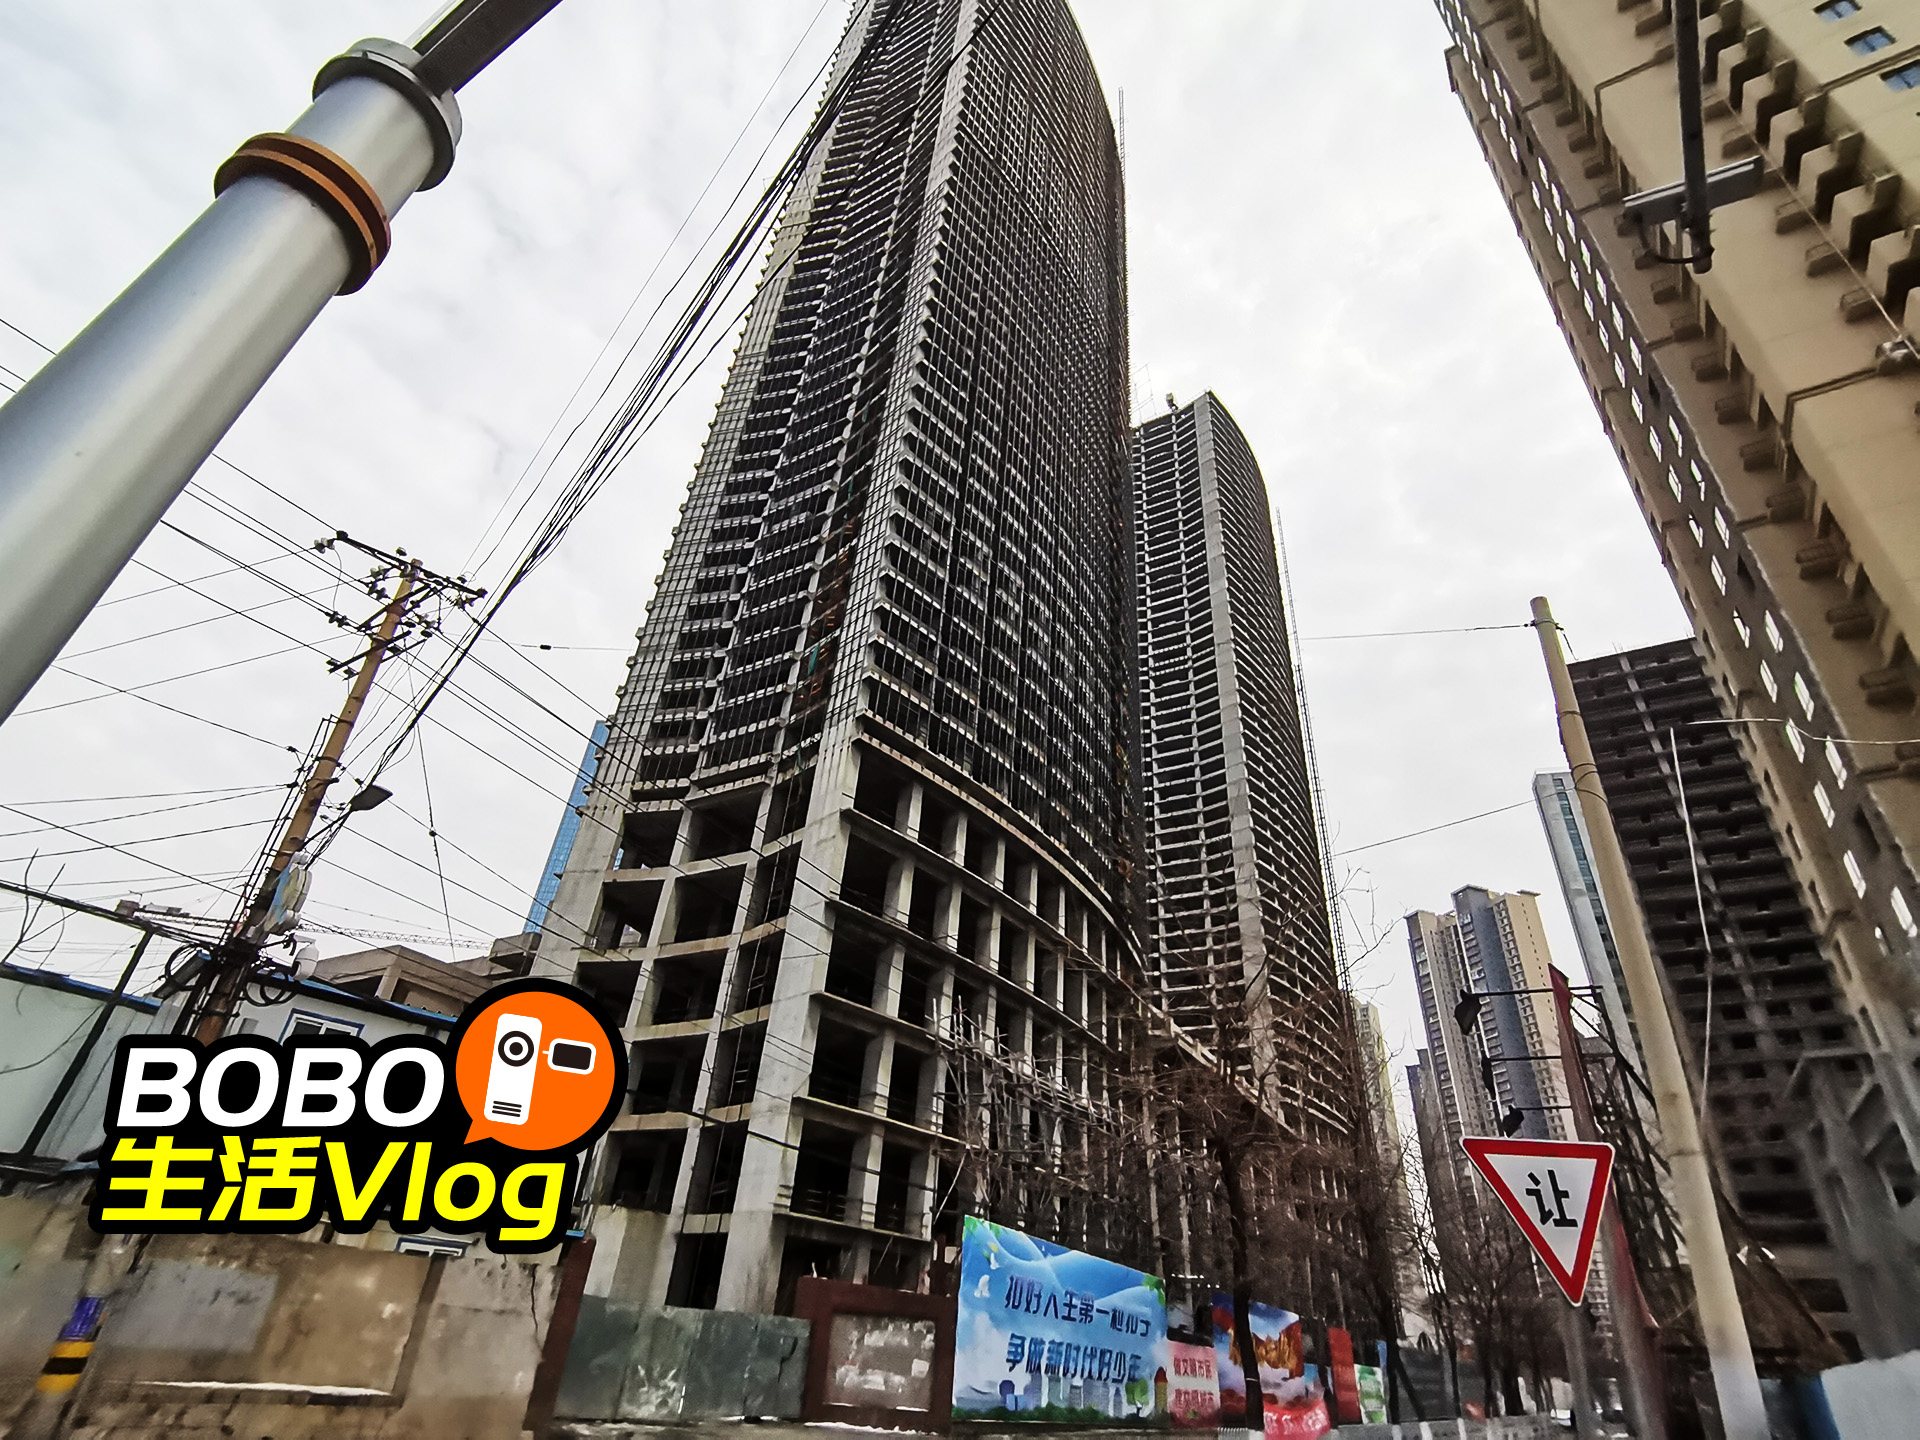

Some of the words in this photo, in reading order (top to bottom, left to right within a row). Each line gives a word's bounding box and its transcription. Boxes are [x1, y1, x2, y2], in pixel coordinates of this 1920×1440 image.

[1525, 1169, 1578, 1227] 让
[1006, 1333, 1142, 1384] 争做新时代好少年
